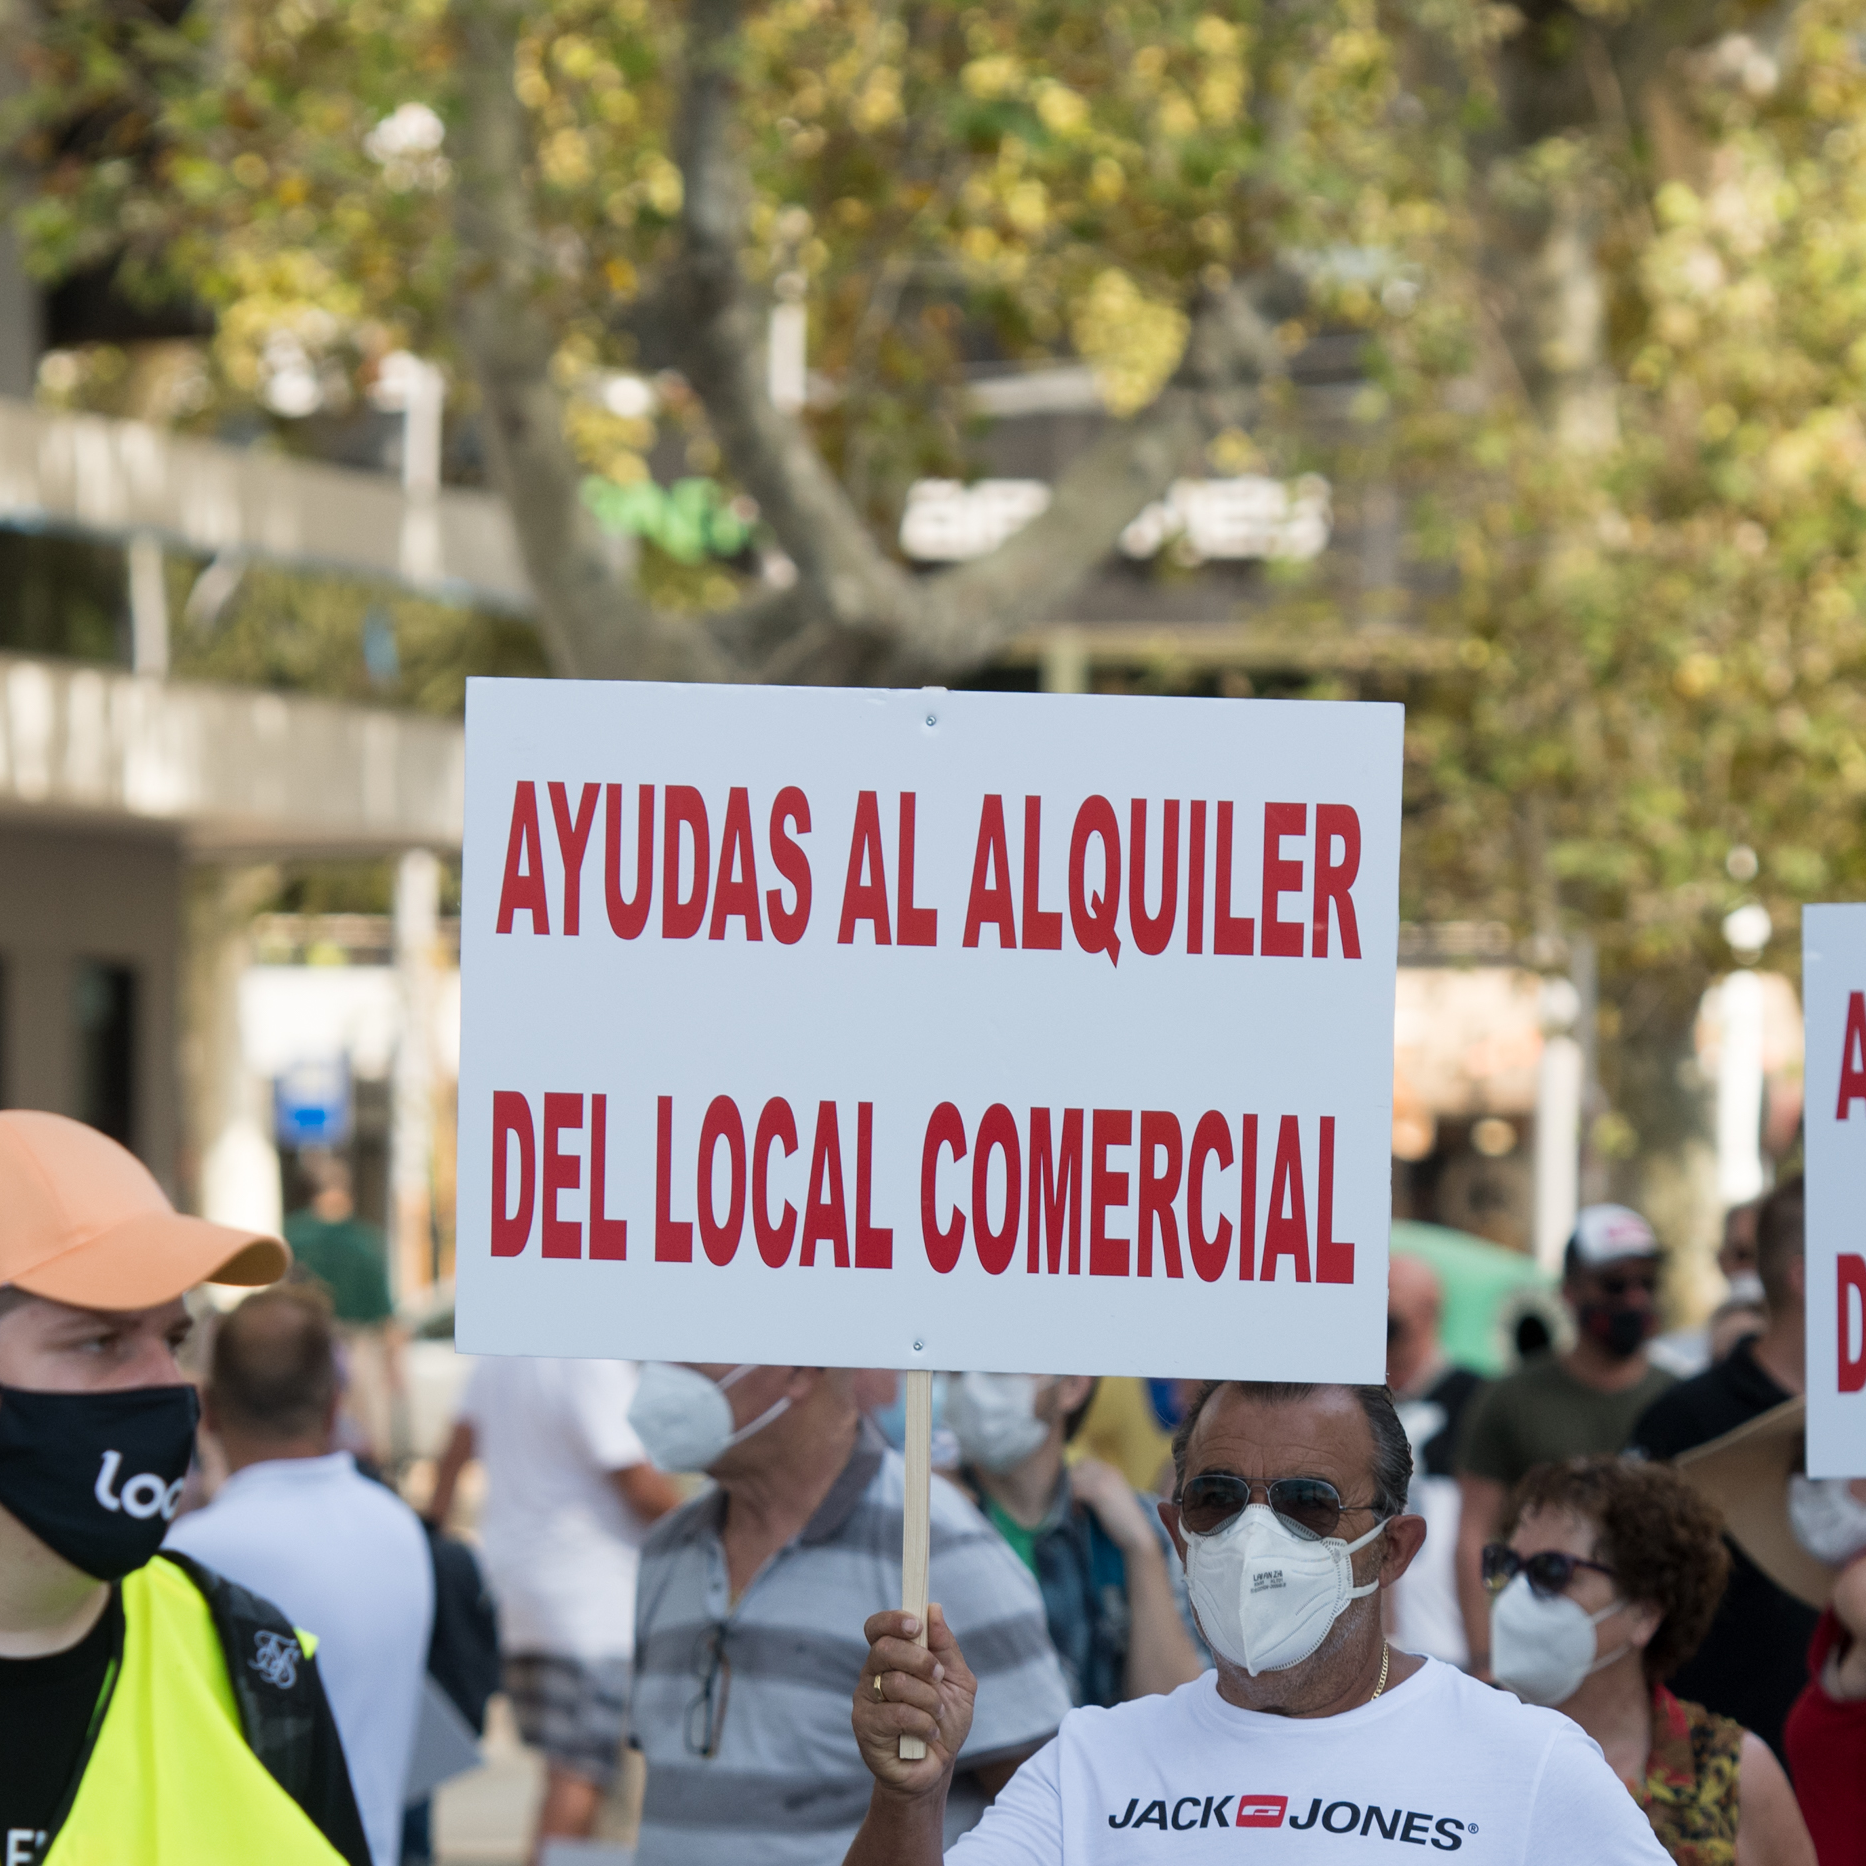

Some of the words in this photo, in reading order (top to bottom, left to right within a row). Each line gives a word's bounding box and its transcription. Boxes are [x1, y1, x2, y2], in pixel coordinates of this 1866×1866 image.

[497, 781, 813, 945] AYUDAS
[838, 791, 938, 947] AL
[963, 795, 1362, 967] ALQUILER
[492, 1091, 627, 1261] DEL
[656, 1095, 893, 1270] LOCAL
[921, 1102, 1355, 1284] COMERCIAL
[1108, 1795, 1235, 1831] JACK
